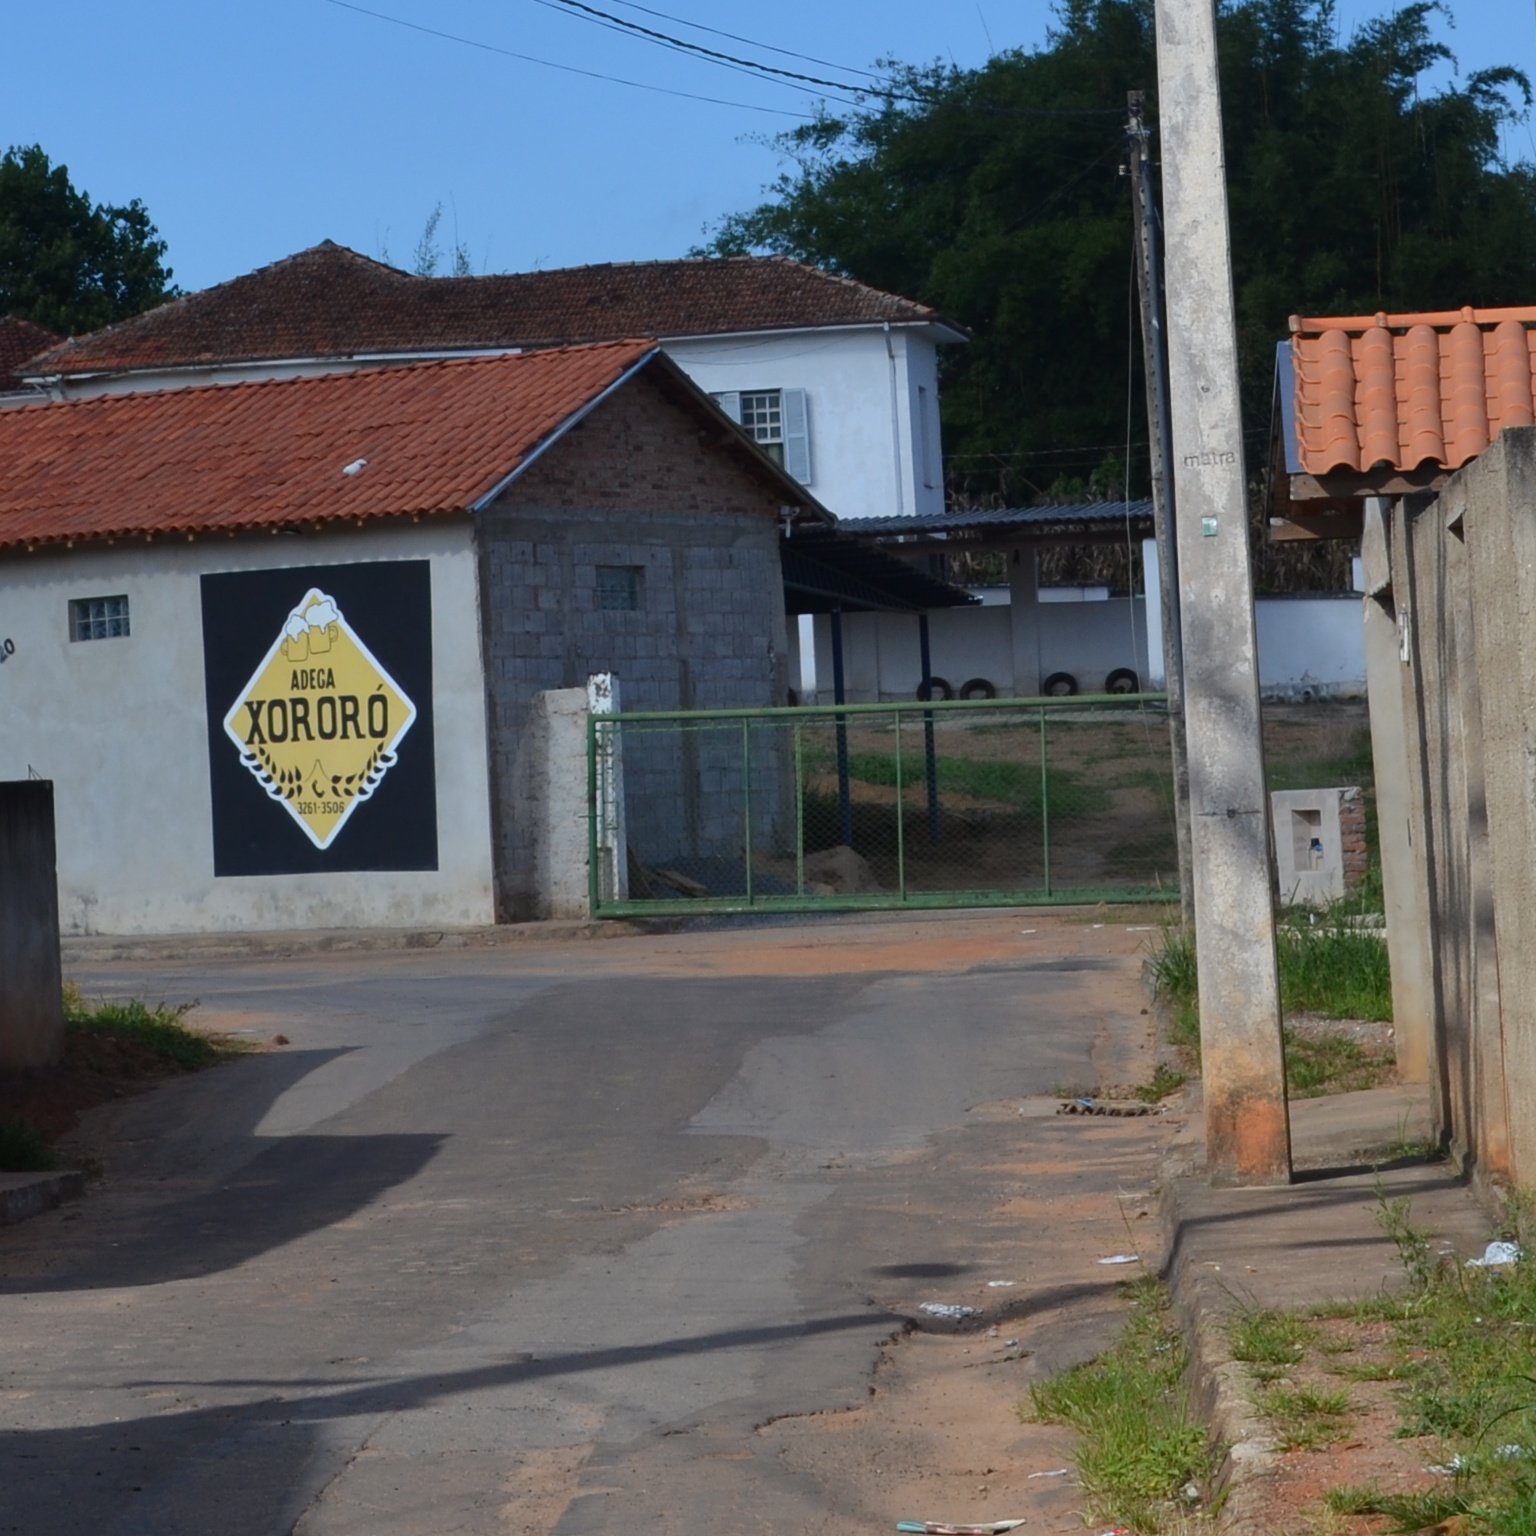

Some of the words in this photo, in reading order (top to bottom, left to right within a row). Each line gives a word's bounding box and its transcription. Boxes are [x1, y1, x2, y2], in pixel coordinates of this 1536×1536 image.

[290, 668, 336, 691] ADEGA
[244, 683, 388, 745] XORORÓ
[297, 801, 345, 815] 3261-3506
